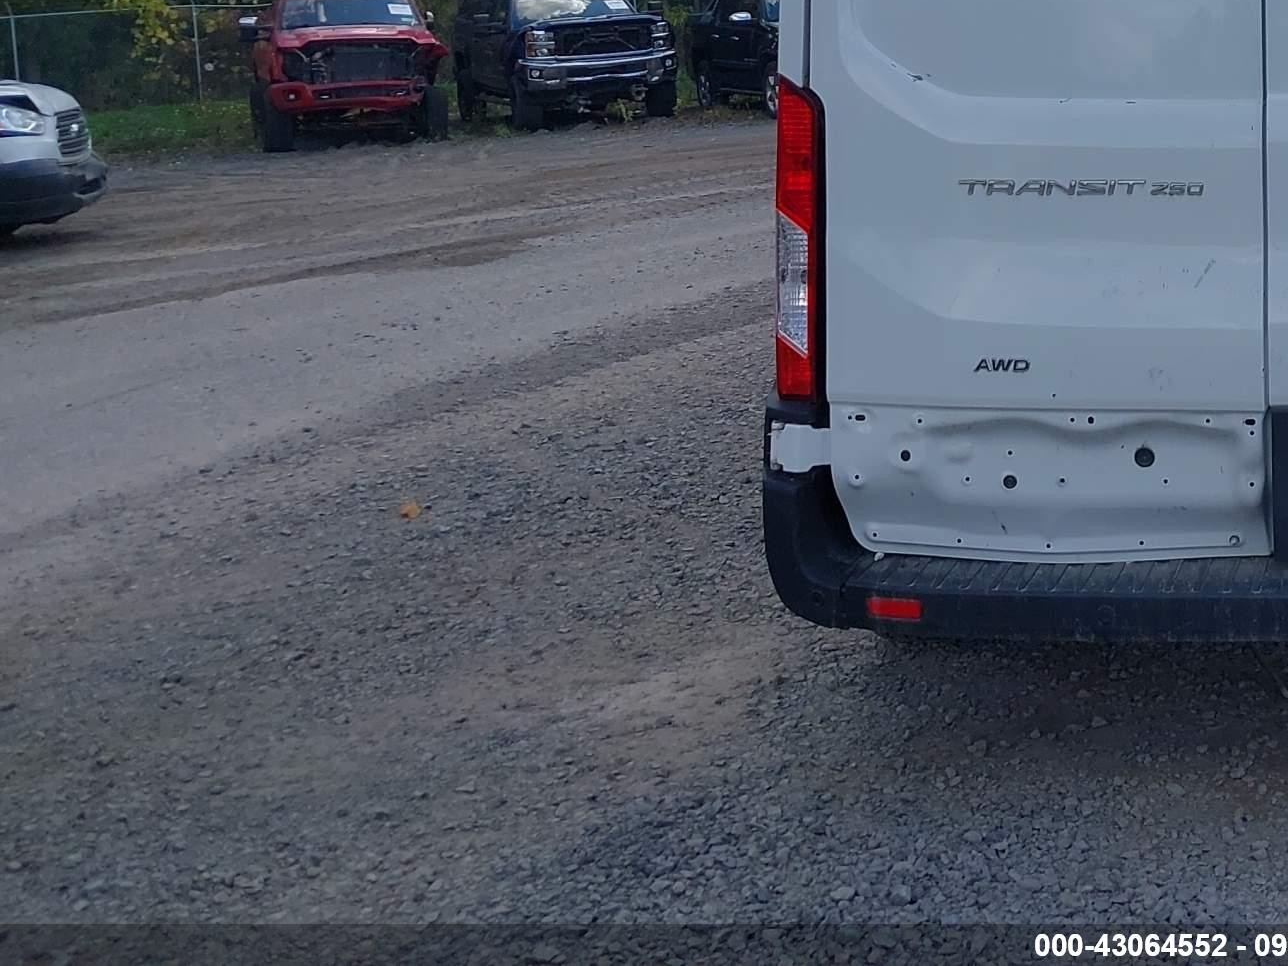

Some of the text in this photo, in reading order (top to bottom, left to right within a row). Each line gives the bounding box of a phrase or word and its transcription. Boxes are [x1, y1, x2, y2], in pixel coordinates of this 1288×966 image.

[958, 179, 1204, 196] TRANSIT 250
[973, 358, 1031, 373] AWD
